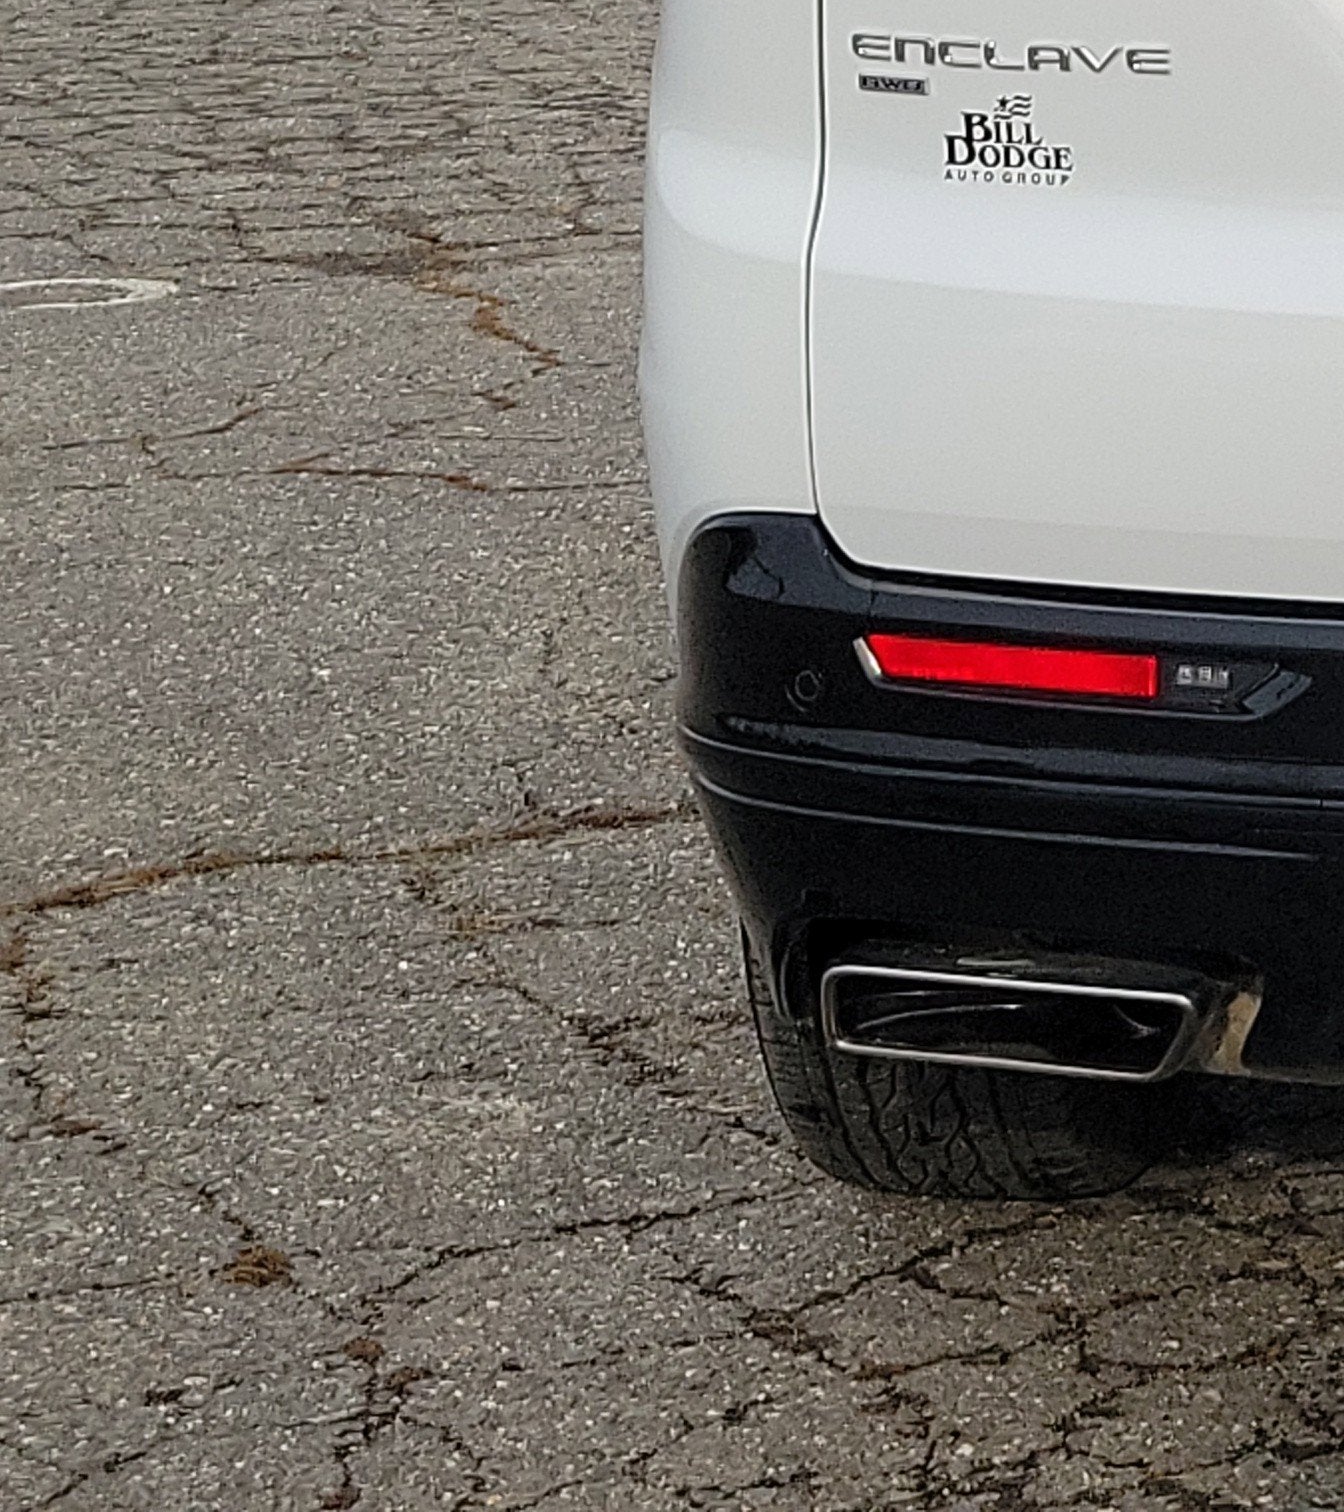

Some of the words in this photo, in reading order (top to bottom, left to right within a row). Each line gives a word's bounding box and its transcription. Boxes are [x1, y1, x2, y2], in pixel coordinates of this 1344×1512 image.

[851, 33, 1171, 75] ENCLAVE
[861, 75, 923, 92] AWD
[961, 110, 1043, 145] BILL
[944, 134, 1074, 171] DODGE
[944, 169, 994, 183] AUTO
[1002, 171, 1070, 186] GROUP
